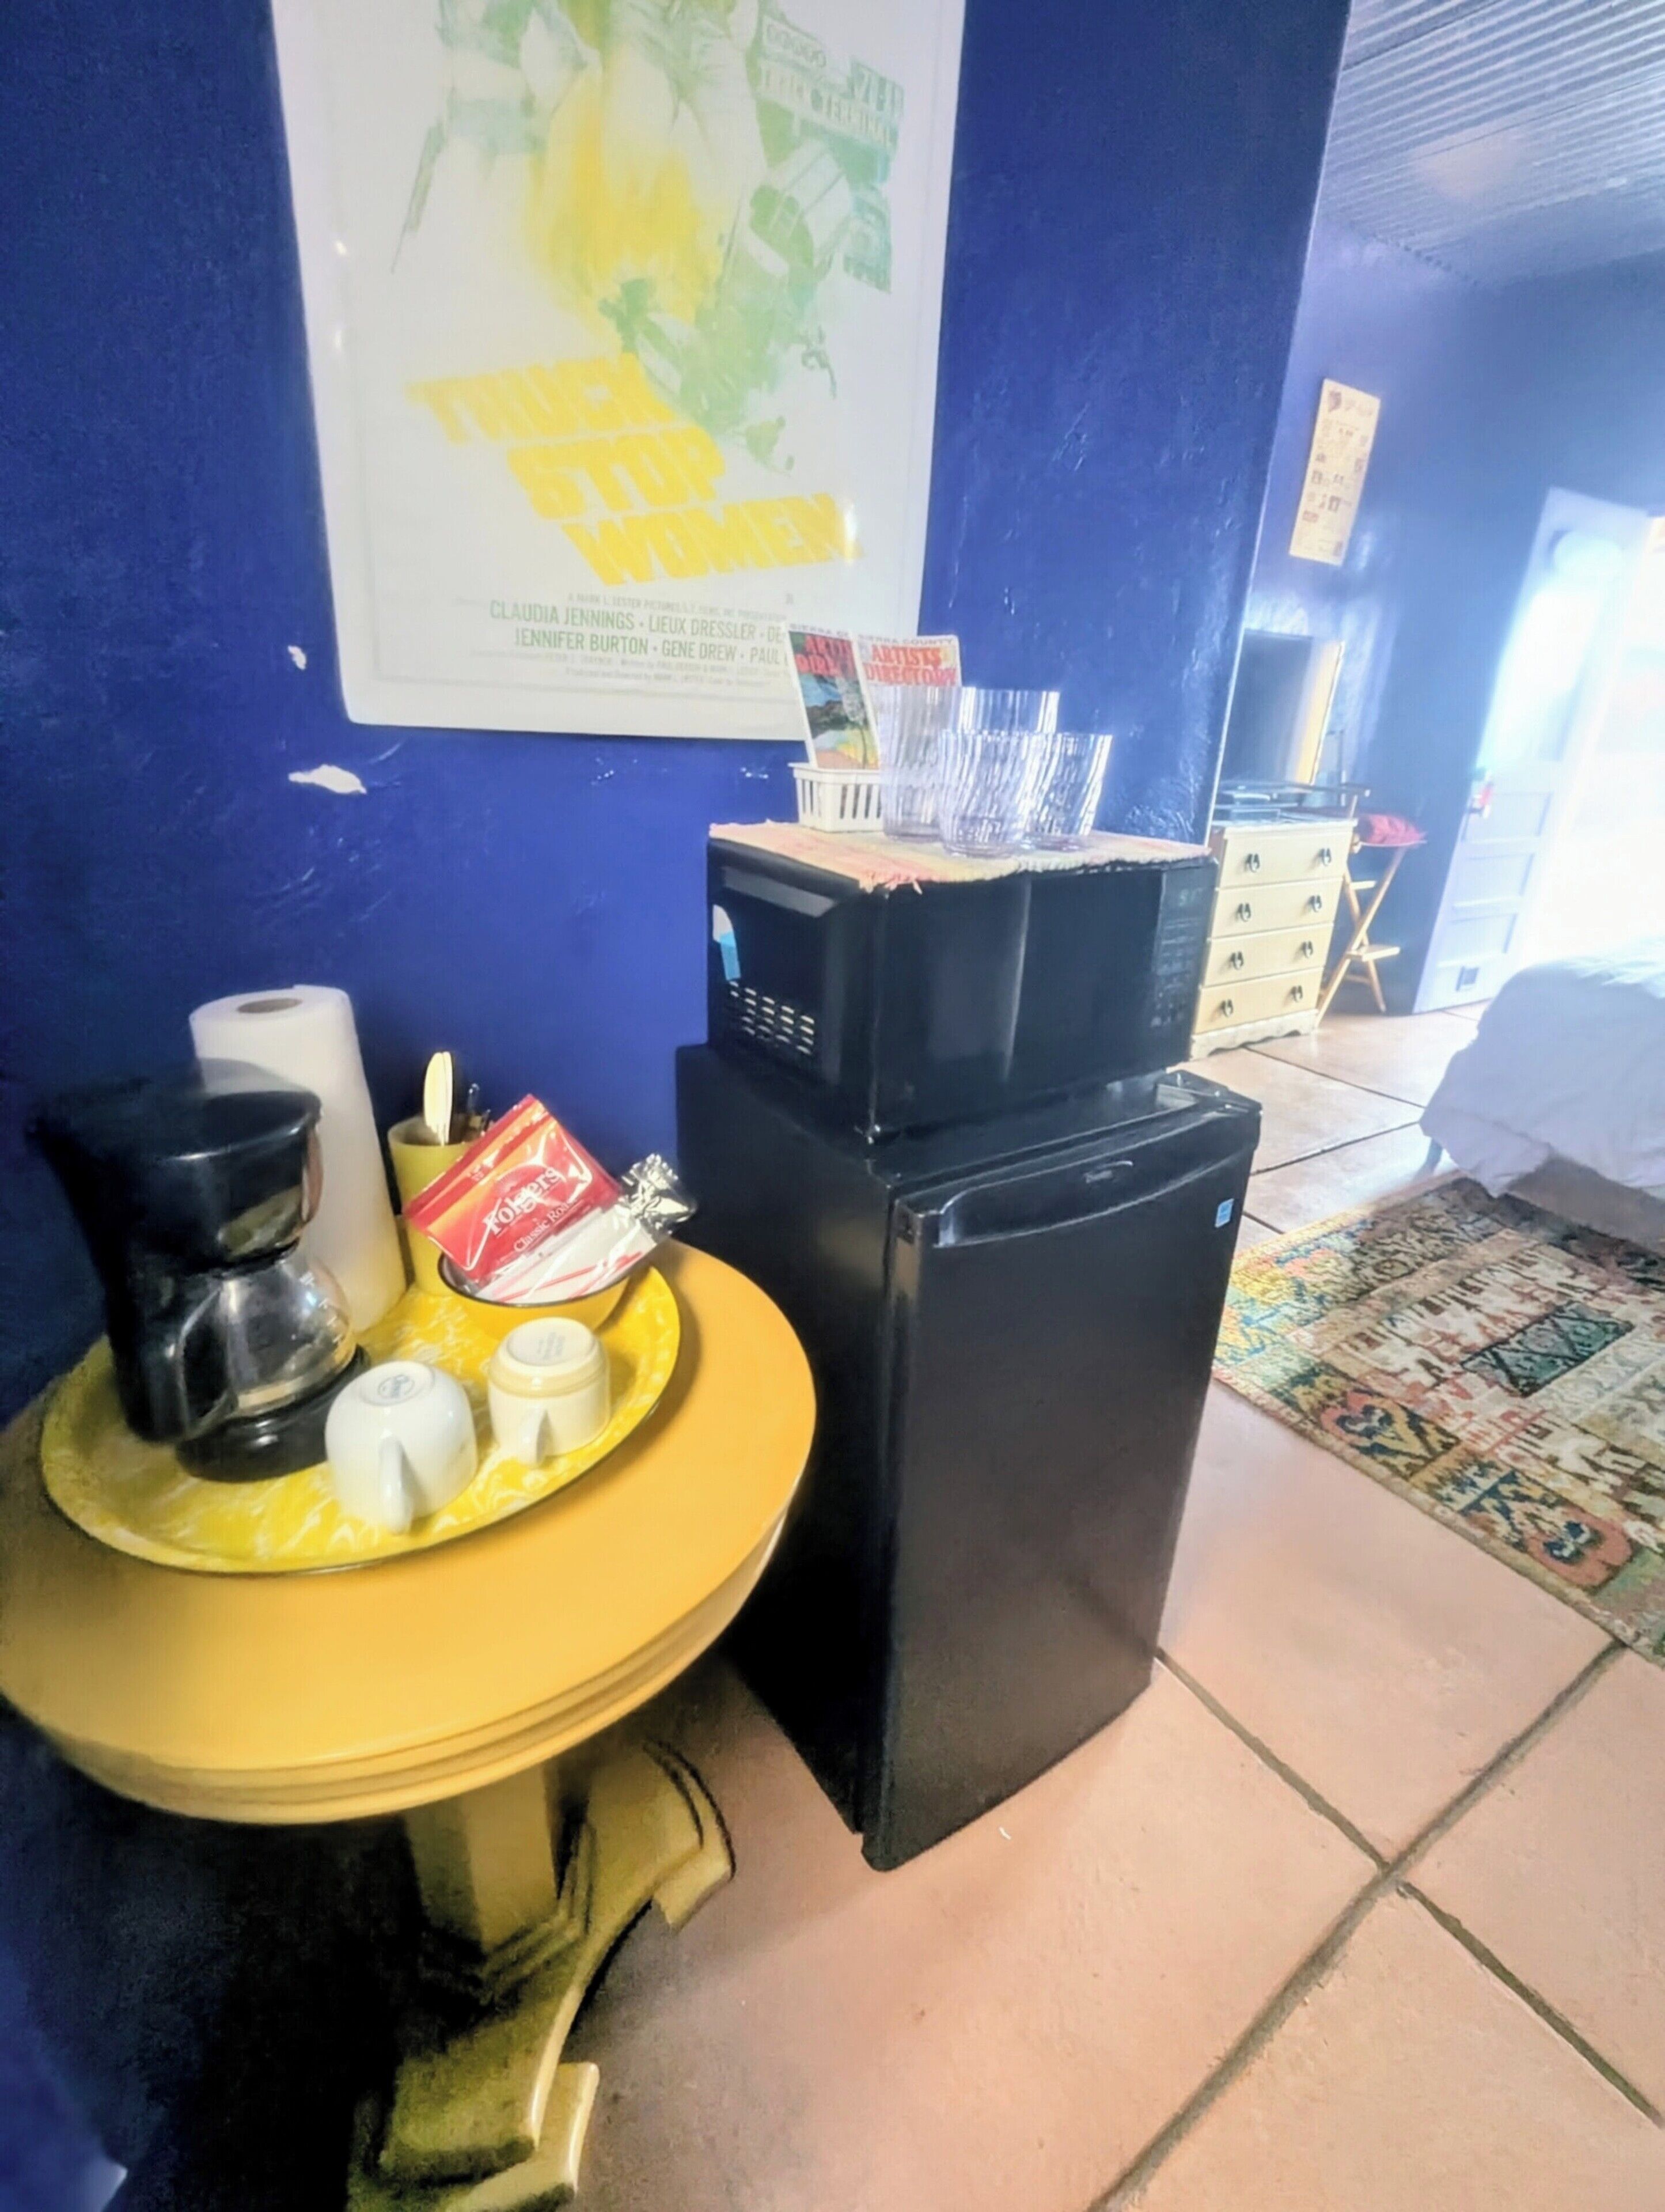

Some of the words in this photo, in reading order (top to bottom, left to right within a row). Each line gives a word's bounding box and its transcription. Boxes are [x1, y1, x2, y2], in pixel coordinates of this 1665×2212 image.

[404, 351, 676, 445] TRUCK
[507, 425, 726, 520] STOP
[562, 493, 864, 586] WOMEN
[490, 599, 560, 624] CLAUDIA
[563, 607, 635, 630] JENNINGS
[648, 613, 687, 635] LIEUX
[691, 618, 756, 641] DRESSLER
[767, 626, 785, 643] DE
[514, 627, 585, 651] JENNIFER
[590, 633, 648, 656] BURTON
[661, 639, 696, 658] GENE
[699, 642, 737, 662] DREW
[749, 646, 780, 665] PAUL
[871, 643, 940, 666] ARTISTS
[482, 1166, 562, 1236] Folgers
[513, 1215, 551, 1254] Classic
